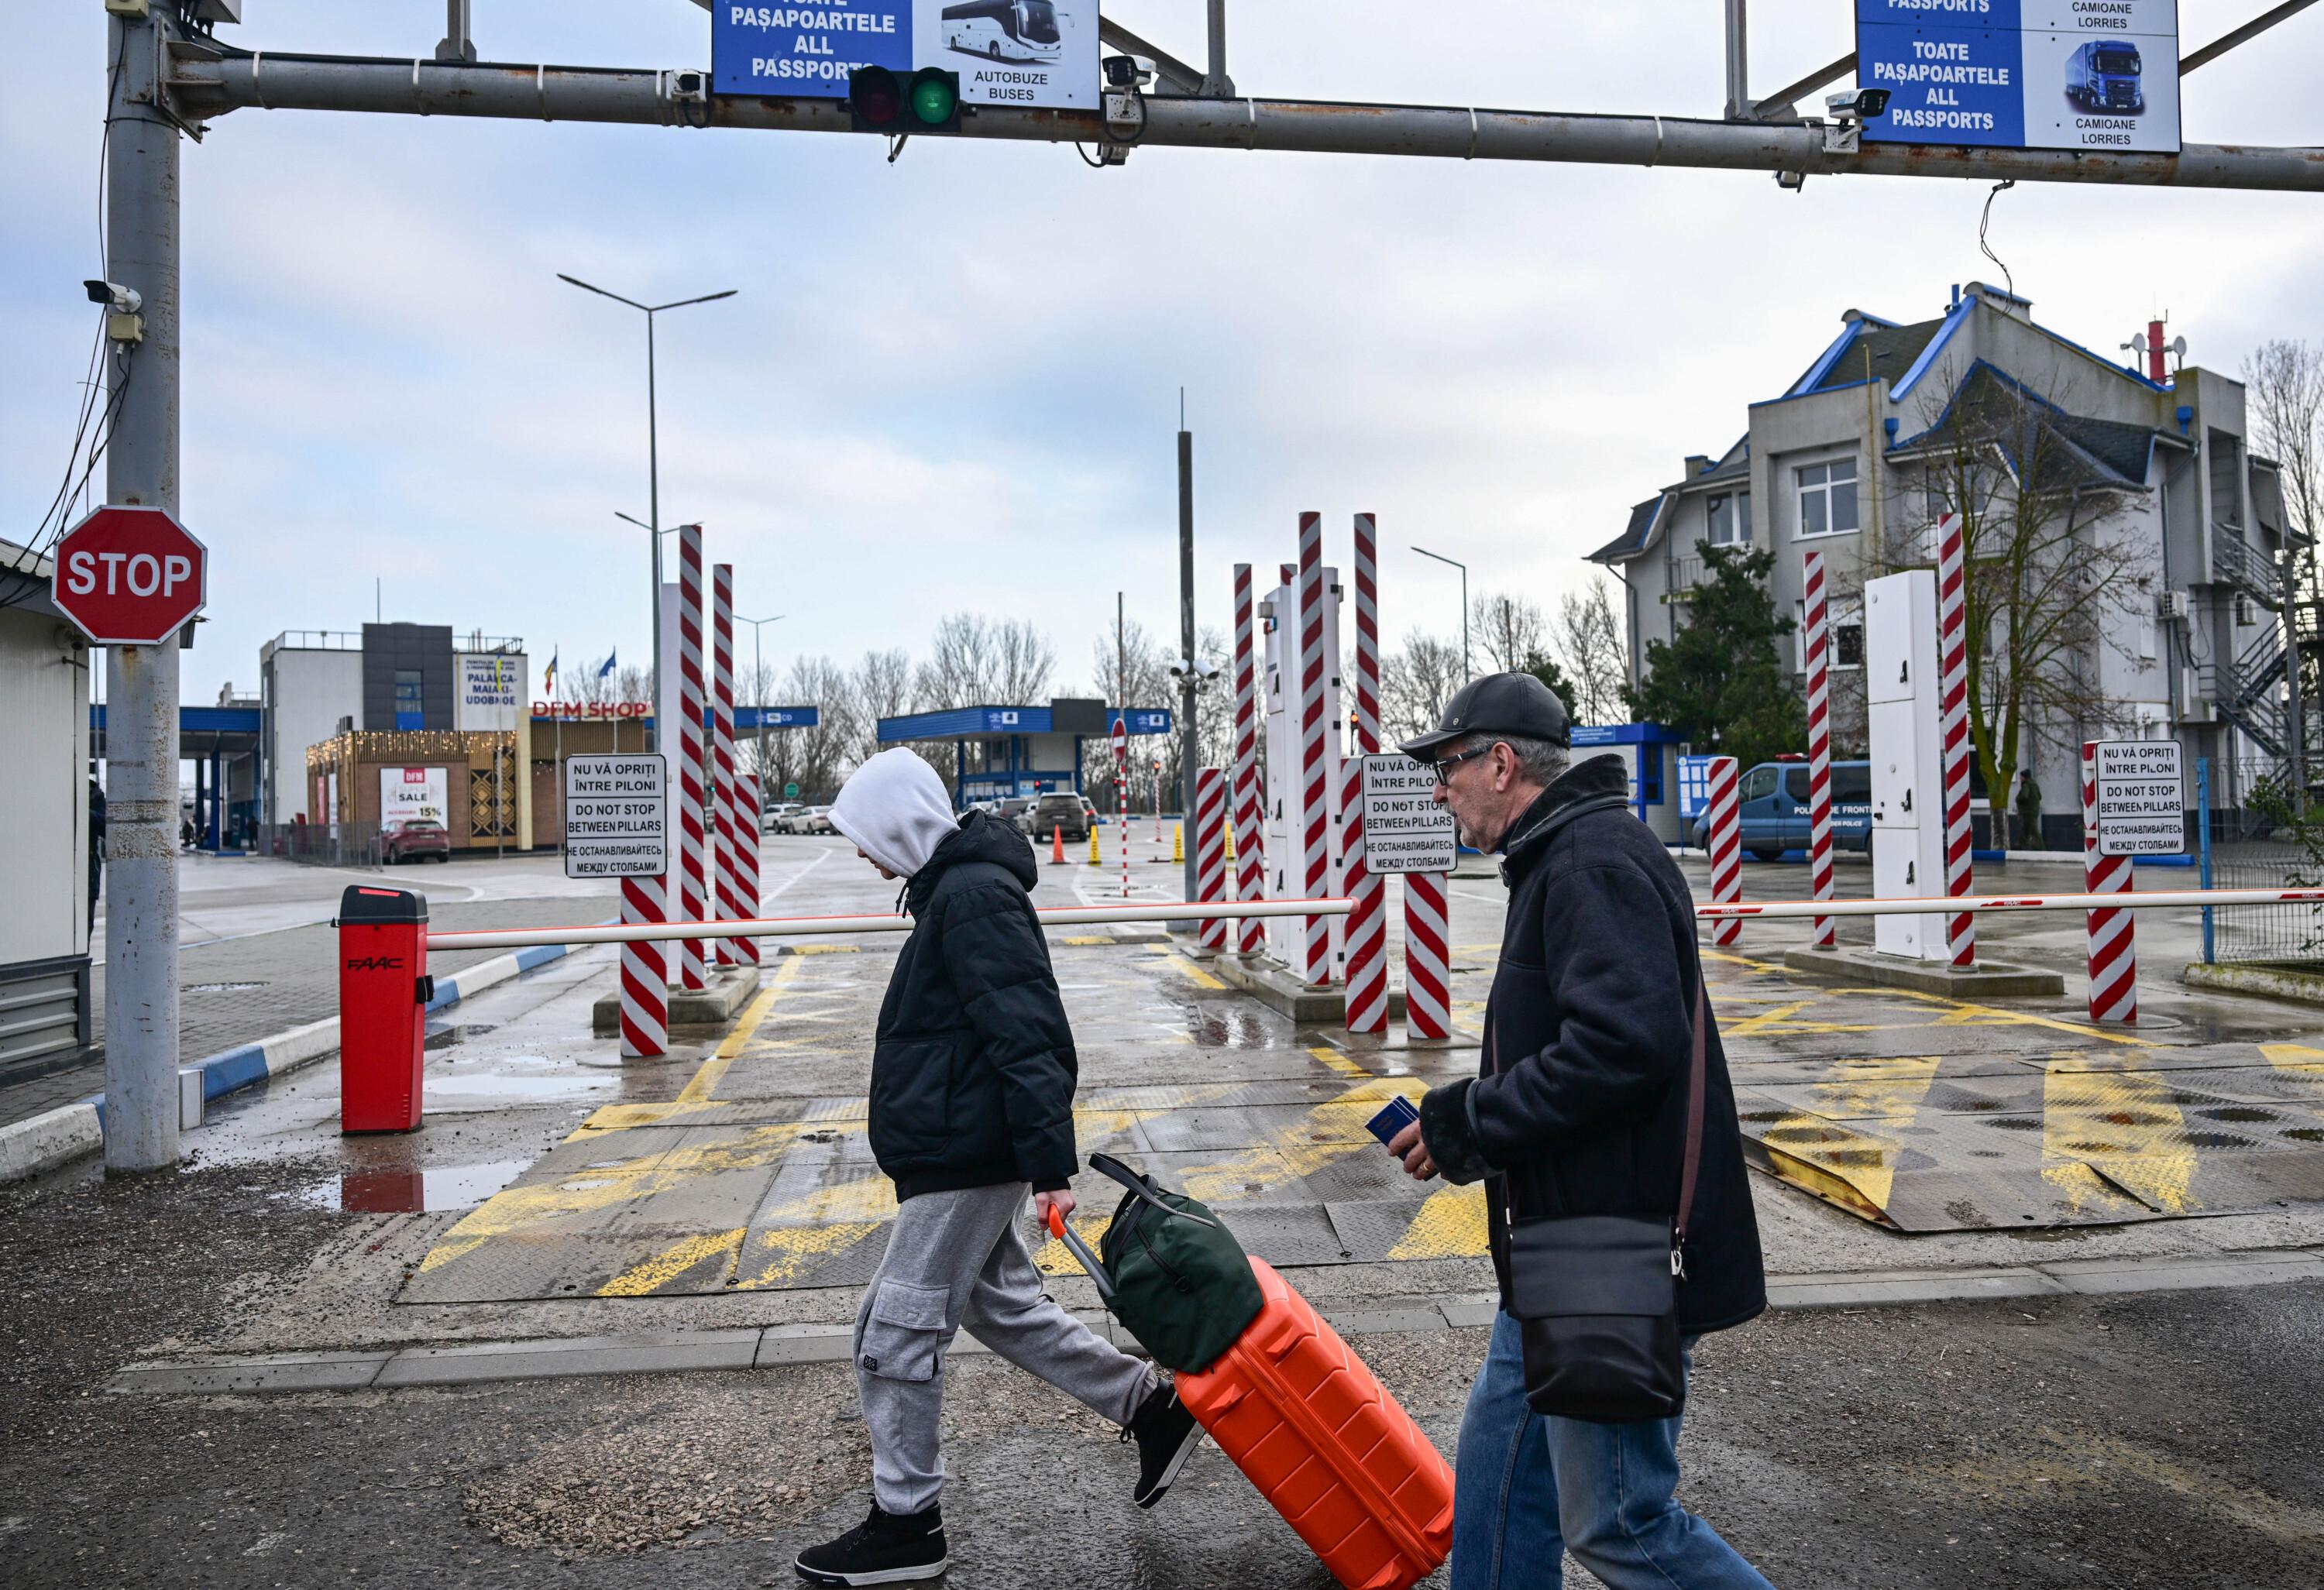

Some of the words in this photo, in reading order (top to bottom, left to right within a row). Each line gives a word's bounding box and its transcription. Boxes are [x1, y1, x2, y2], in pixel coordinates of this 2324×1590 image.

[2072, 2, 2132, 14] CAMIOANE
[731, 6, 896, 33] PAȘAPOARTELE
[2078, 17, 2127, 29] LORRIES
[794, 35, 834, 55] ALL
[1913, 41, 1969, 61] TOATE
[752, 57, 875, 81] PASSPOR
[1874, 62, 2009, 86] PAȘAPOARTELE
[975, 70, 1048, 84] AUTOBUZE
[989, 88, 1034, 101] BUSES
[1926, 88, 1959, 105] ALL
[1892, 108, 1994, 130] PASSPORTS
[2076, 118, 2136, 130] CAMIOANE
[2082, 133, 2131, 145] LORRIES
[67, 551, 191, 597] STOP
[533, 701, 583, 717] DFM
[588, 702, 647, 718] SHOP
[2104, 749, 2119, 758] NU
[2122, 746, 2137, 757] VĂ
[574, 764, 590, 774] NU
[595, 762, 611, 774] VĂ
[1370, 762, 1385, 772] NU
[1389, 759, 1404, 771] VĂ
[1408, 761, 1435, 771] OPR
[2106, 763, 2137, 774] ÎNTRE
[2140, 764, 2174, 773] PILONI
[575, 779, 611, 791] ÎNTRE
[615, 781, 655, 791] PILONI
[1371, 776, 1404, 788] ÎNTRE
[1408, 777, 1438, 787] PILO
[399, 793, 428, 802] SALE
[2107, 787, 2122, 797] DO
[2125, 786, 2146, 796] NOT
[2149, 786, 2175, 796] STOP
[420, 807, 442, 817] 15%
[576, 805, 593, 816] DO
[596, 805, 621, 816] NOT
[624, 804, 655, 815] STOP
[1373, 802, 1389, 812] DO
[1392, 801, 1414, 812] NOT
[2101, 802, 2142, 812] BETWEEN
[2144, 801, 2181, 812] PILLARS
[569, 821, 616, 833] BETWEEN
[617, 821, 661, 831] PILLARS
[1412, 816, 1452, 827] PILLARS
[2100, 826, 2109, 835] НЕ
[2111, 822, 2182, 834] ОСТАНАВЛИВАЙТЕСЬ
[567, 847, 577, 856] НЕ
[579, 843, 662, 856] ОСТАНАВЛИВАЙТЕСЬ
[1367, 843, 1376, 852] НЕ
[1377, 839, 1453, 851] ОСТАНАВЛИВАЙТЕСЬ
[2109, 841, 2137, 851] МЕЖДУ
[2138, 840, 2178, 850] СТОЛБАМИ
[576, 863, 608, 874] МЕЖДУ
[610, 862, 657, 872] СТОЛБАМИ
[1376, 858, 1404, 869] МЕЖДУ
[1407, 857, 1450, 867] СТОЛБАМИ
[347, 956, 404, 971] FAAC
